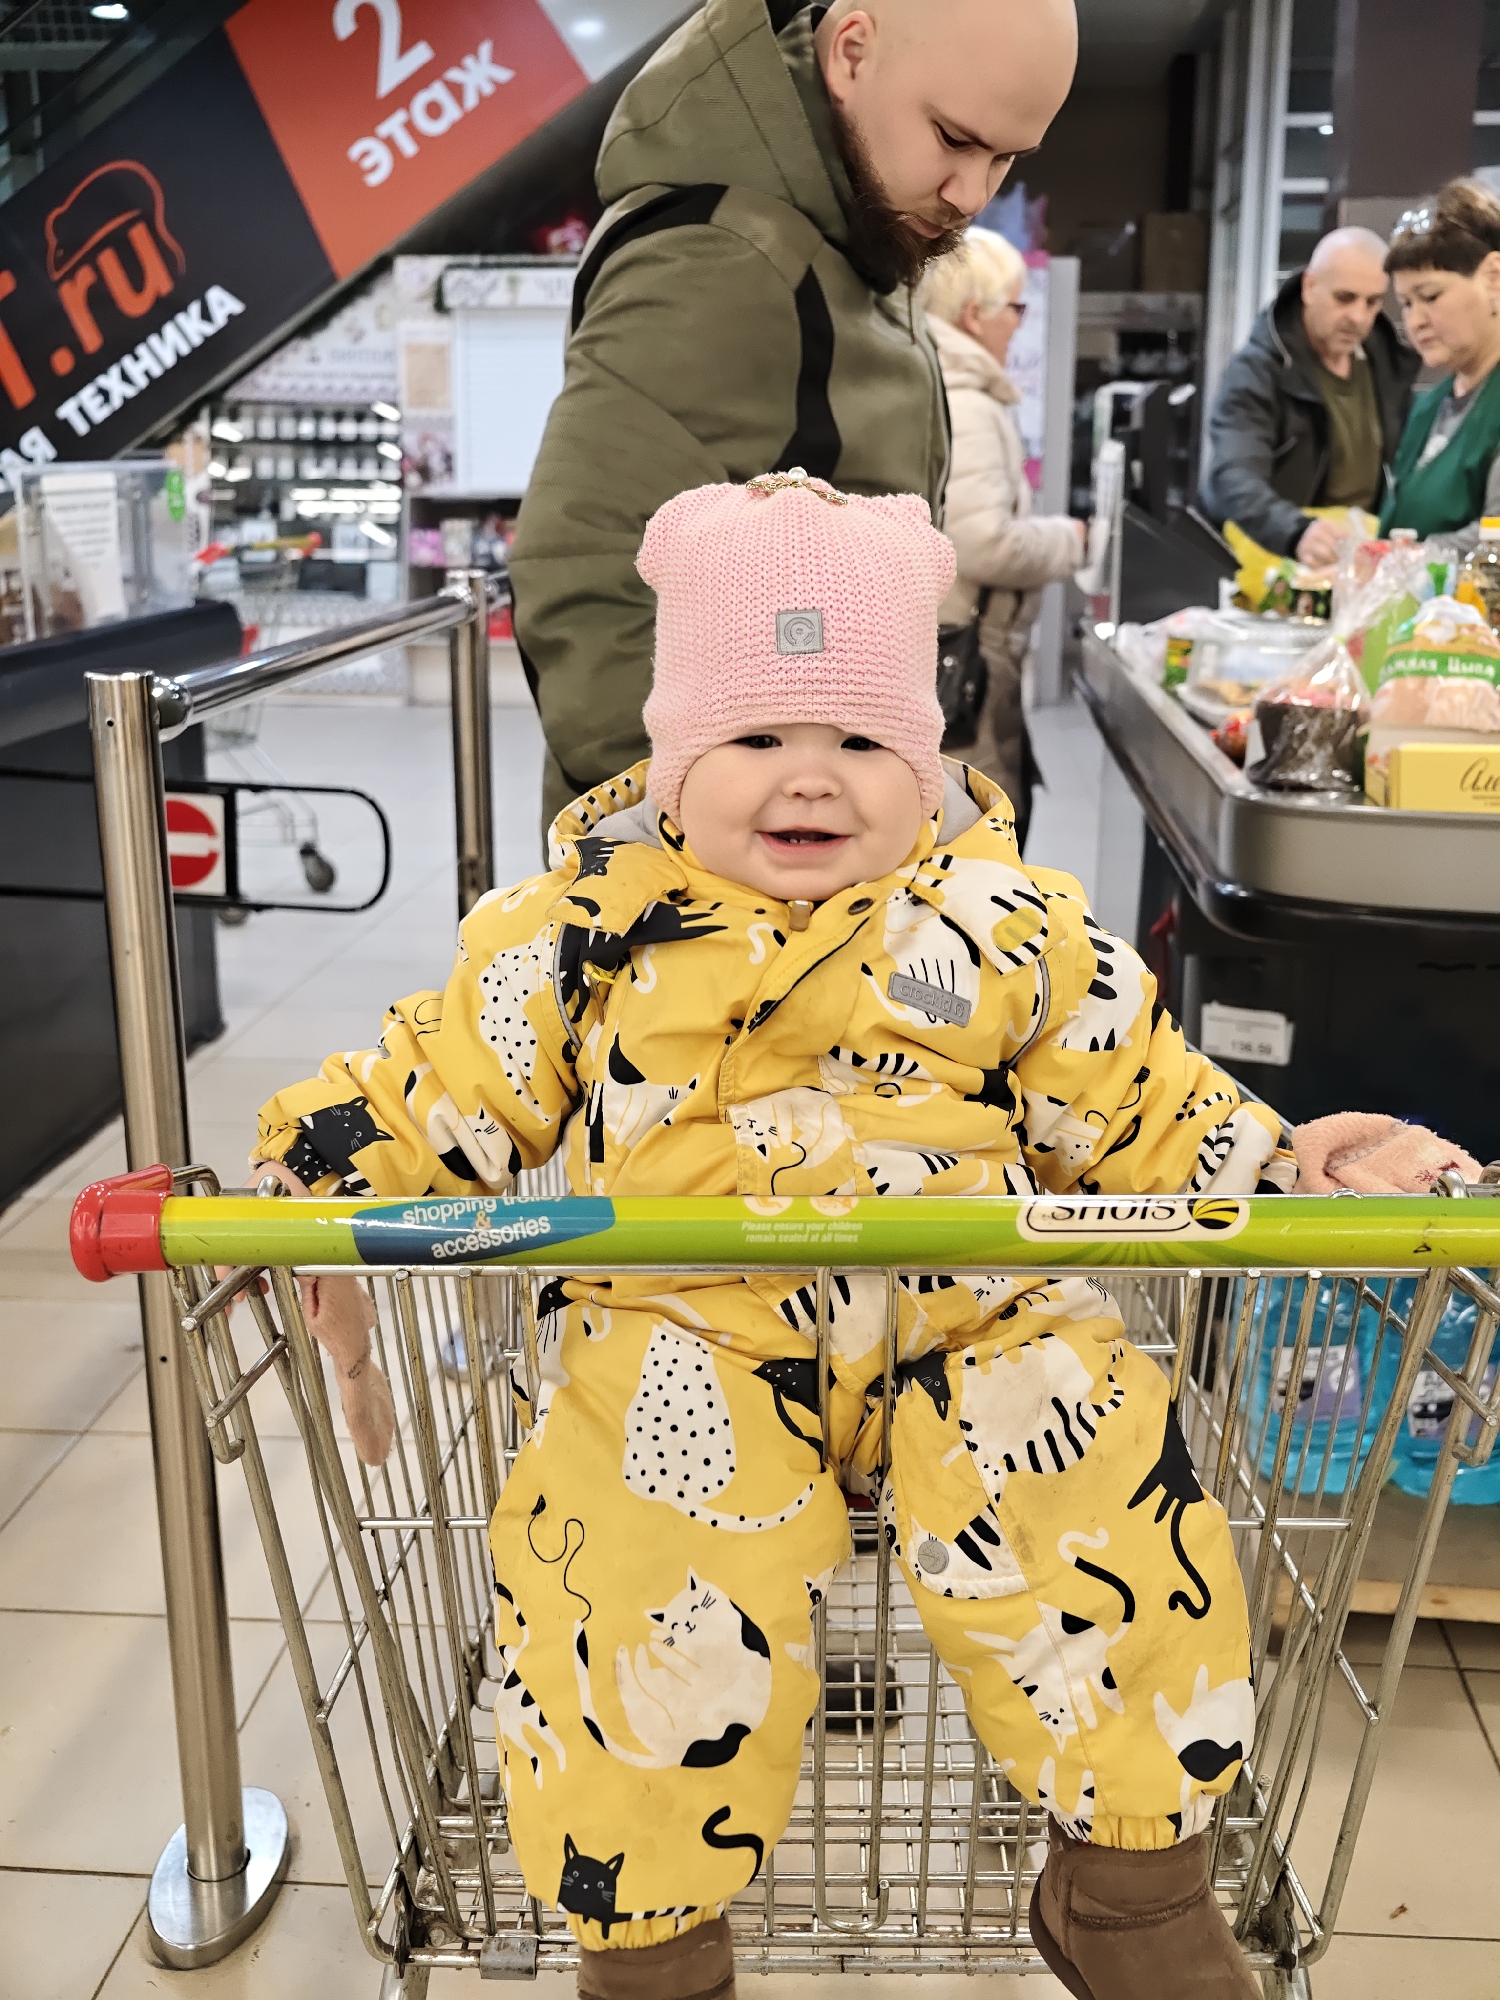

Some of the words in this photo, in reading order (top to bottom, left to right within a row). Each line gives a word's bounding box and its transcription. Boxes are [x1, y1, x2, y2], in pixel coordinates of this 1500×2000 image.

[332, 0, 435, 99] 2
[347, 37, 516, 188] этаж
[55, 284, 246, 437] ТЕХНИКА
[899, 984, 953, 1013] crockid
[402, 1198, 498, 1226] shopping
[474, 1210, 492, 1230] &
[430, 1215, 552, 1259] accessories
[741, 1220, 772, 1232] Please
[773, 1222, 804, 1232] ensure
[805, 1222, 826, 1234] your
[827, 1220, 863, 1232] children
[745, 1231, 776, 1243] remain
[778, 1231, 809, 1243] seated
[809, 1233, 819, 1243] at
[820, 1231, 833, 1243] all
[833, 1231, 859, 1243] times
